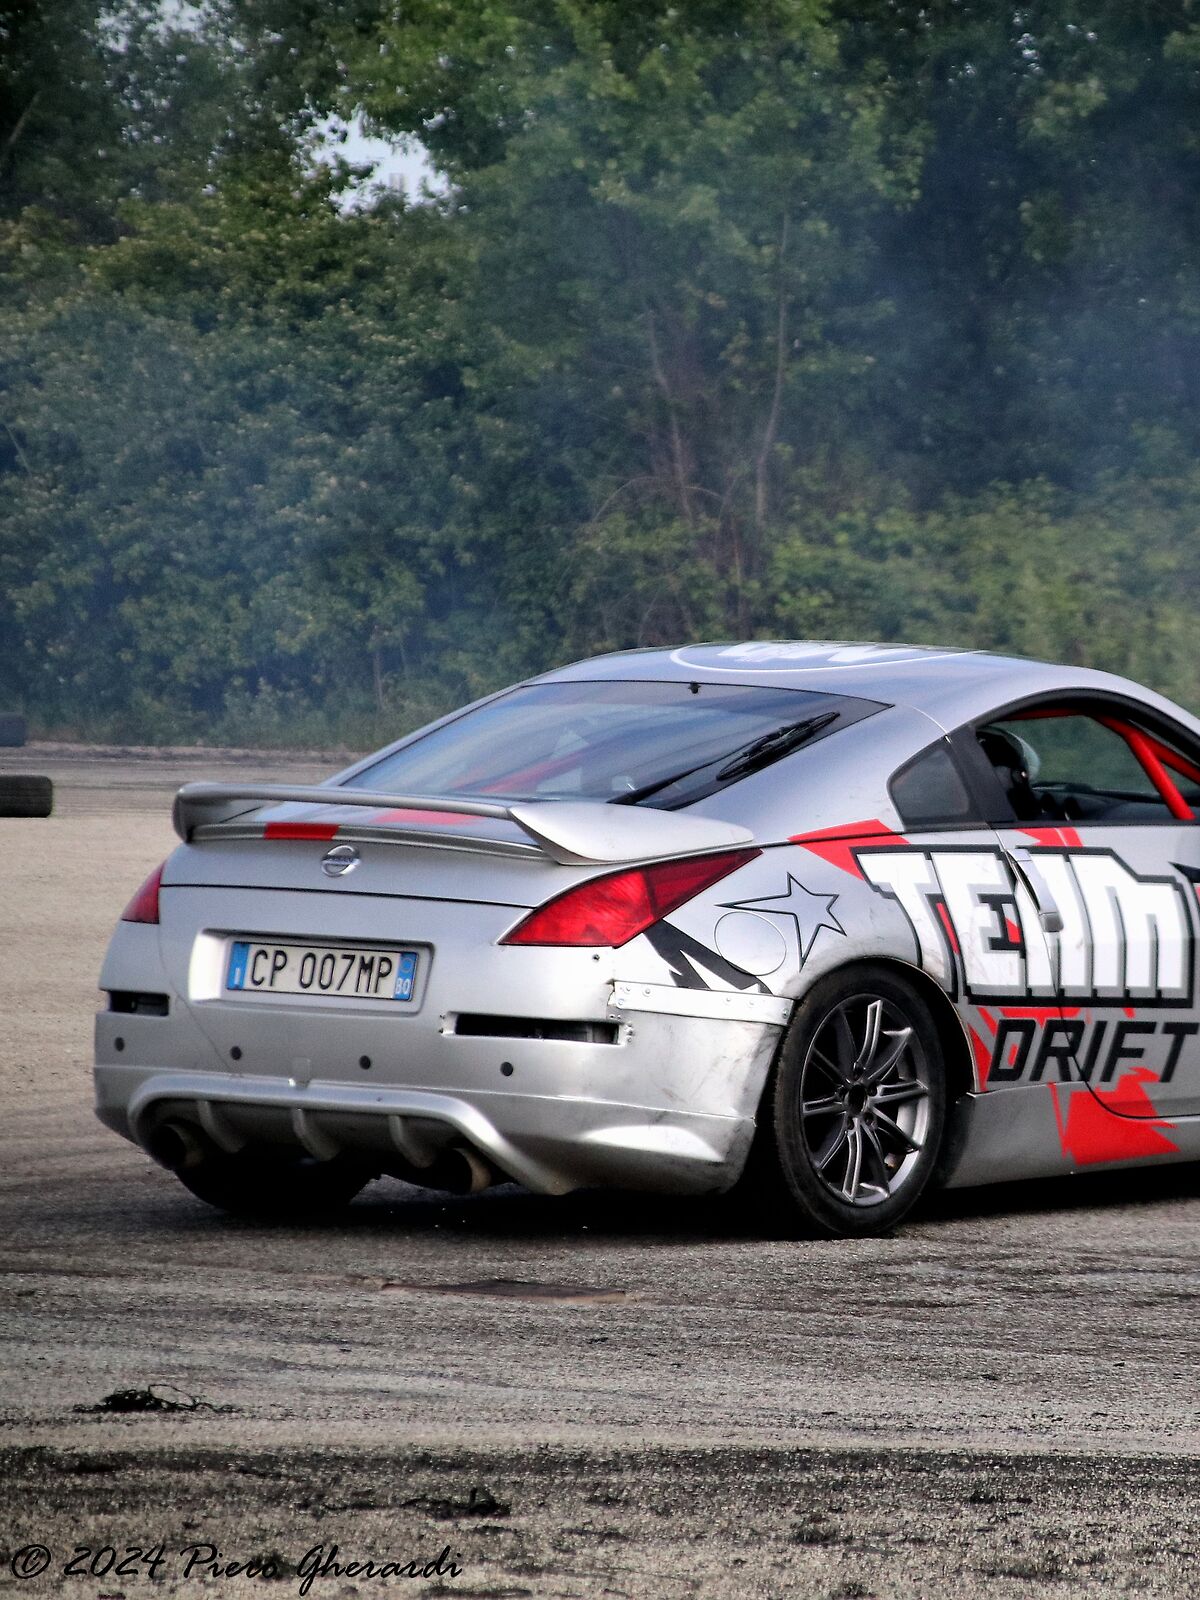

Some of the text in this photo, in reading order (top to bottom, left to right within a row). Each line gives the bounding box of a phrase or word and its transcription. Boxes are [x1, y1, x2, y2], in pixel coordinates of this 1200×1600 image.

[250, 949, 393, 993] CP 007MP
[985, 1018, 1199, 1084] DRIFT
